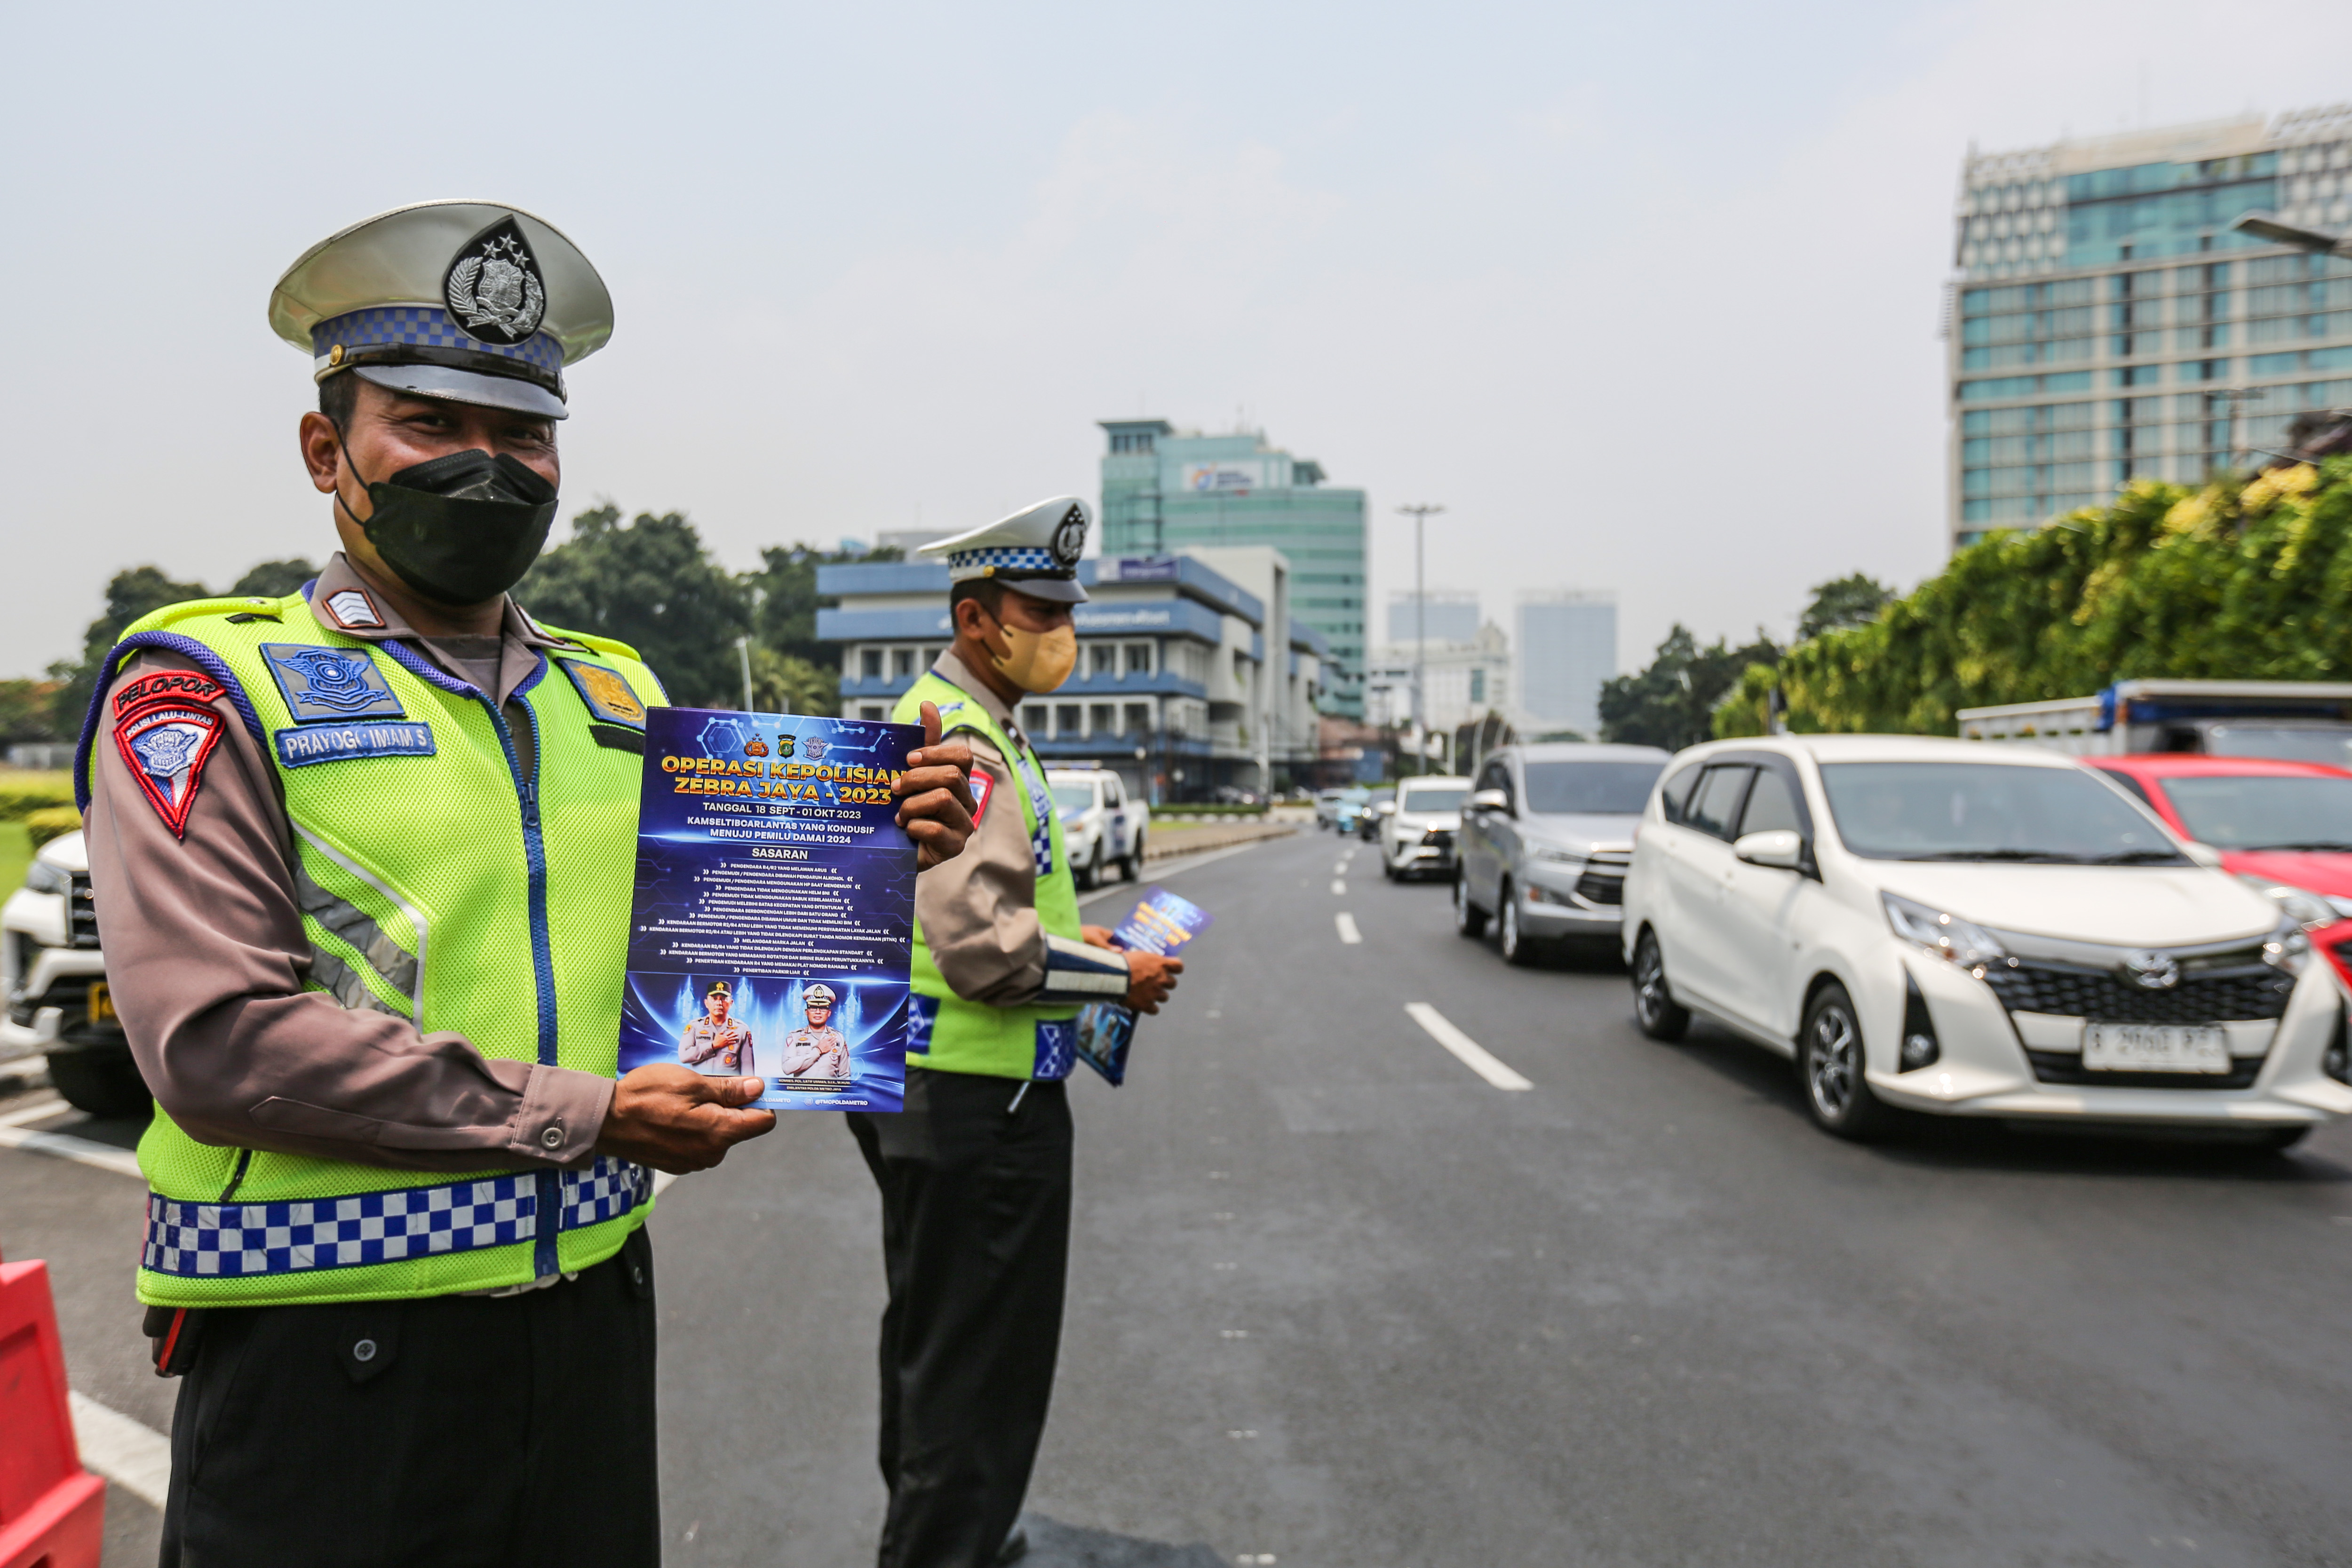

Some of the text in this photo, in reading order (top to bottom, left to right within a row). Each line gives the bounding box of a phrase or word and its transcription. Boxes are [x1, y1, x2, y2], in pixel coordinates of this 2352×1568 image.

[118, 677, 216, 709] PELOPOR
[126, 711, 214, 737] POLISI LALU-LINTAS
[369, 728, 413, 748] IMAM
[417, 729, 427, 747] S
[662, 756, 763, 777] OPERASI
[675, 777, 753, 797] ZEBRA
[758, 782, 819, 801] JAYA
[839, 786, 892, 805] 2023
[702, 802, 752, 812] TANGGAL
[770, 806, 795, 815] SEPT
[814, 808, 835, 817] OKT
[836, 810, 861, 819] 2023
[687, 817, 797, 830] KAMSELTIBCARLANTAS
[827, 824, 874, 834] KONDUSIF
[710, 828, 851, 844] MENUJU PEMILU DAMAI 2024
[752, 848, 808, 859] SASARAN
